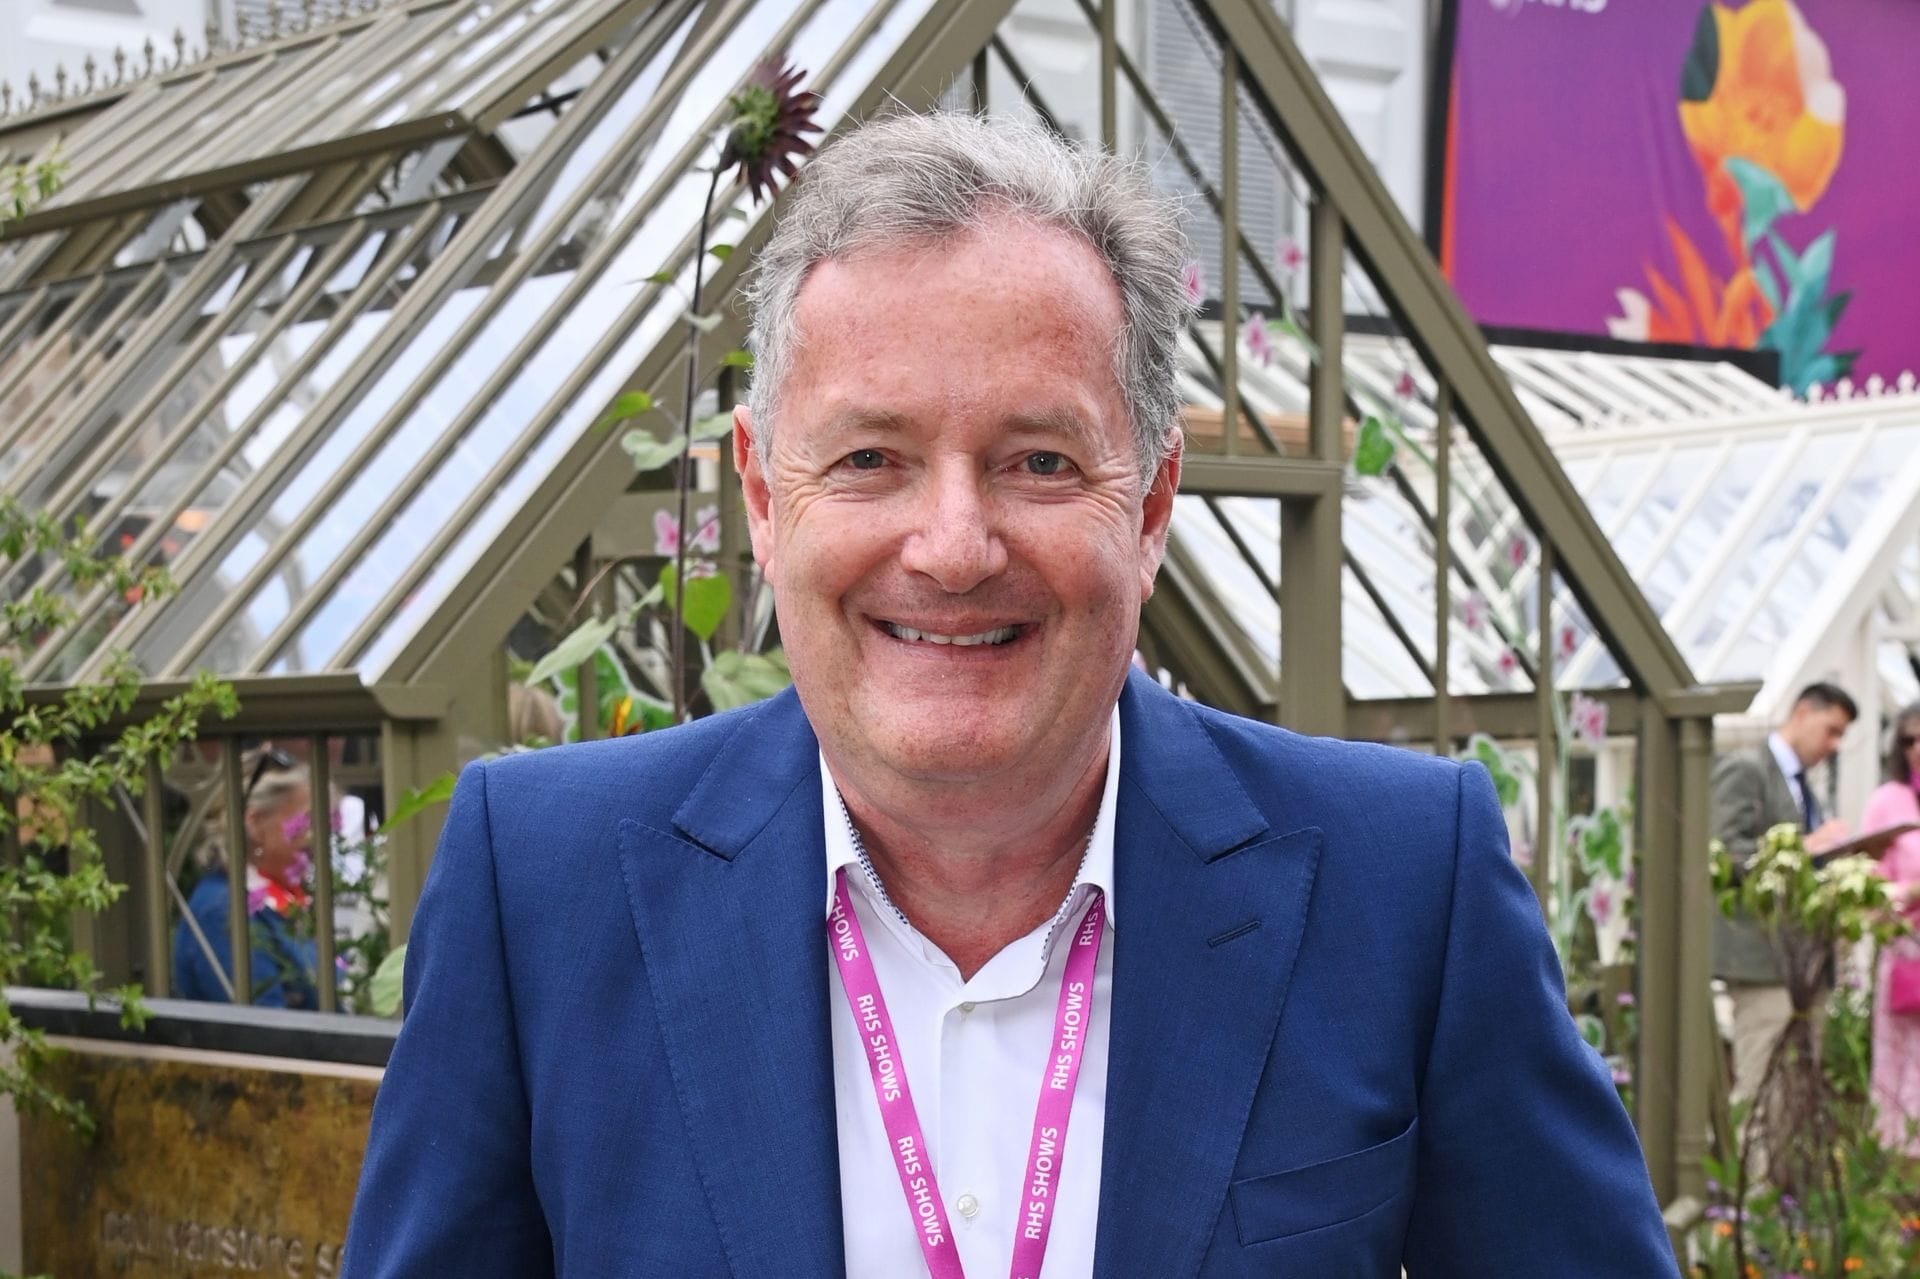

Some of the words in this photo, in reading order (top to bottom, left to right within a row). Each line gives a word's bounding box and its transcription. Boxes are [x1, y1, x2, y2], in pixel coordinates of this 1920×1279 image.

[1079, 912, 1098, 946] RHS
[857, 994, 882, 1033] RHS
[870, 1034, 901, 1103] SHOWS
[1060, 981, 1085, 1058] SHOWS
[1050, 1056, 1073, 1091] RHS
[898, 1136, 922, 1176] RHS
[910, 1177, 944, 1247] SHOWS
[1032, 1127, 1058, 1199] SHOWS
[1024, 1200, 1046, 1240] RHS
